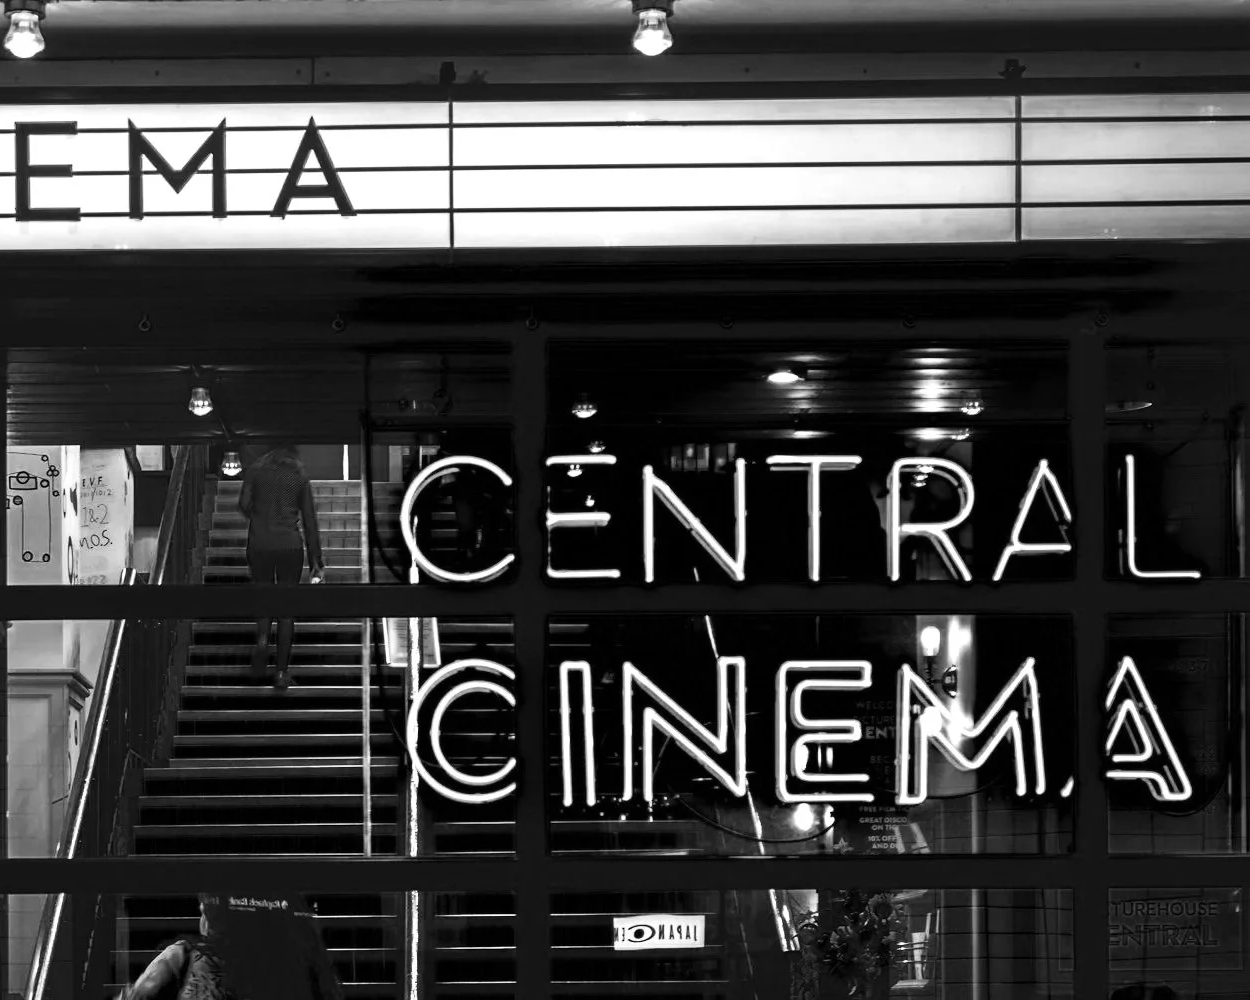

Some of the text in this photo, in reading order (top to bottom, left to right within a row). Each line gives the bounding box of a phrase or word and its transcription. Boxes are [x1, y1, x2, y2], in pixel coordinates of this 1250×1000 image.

[400, 454, 1202, 584] CENTRAL
[407, 654, 1192, 807] CINEMA
[1109, 924, 1219, 946] ENTRAL
[1110, 902, 1219, 917] TUREHOUSE
